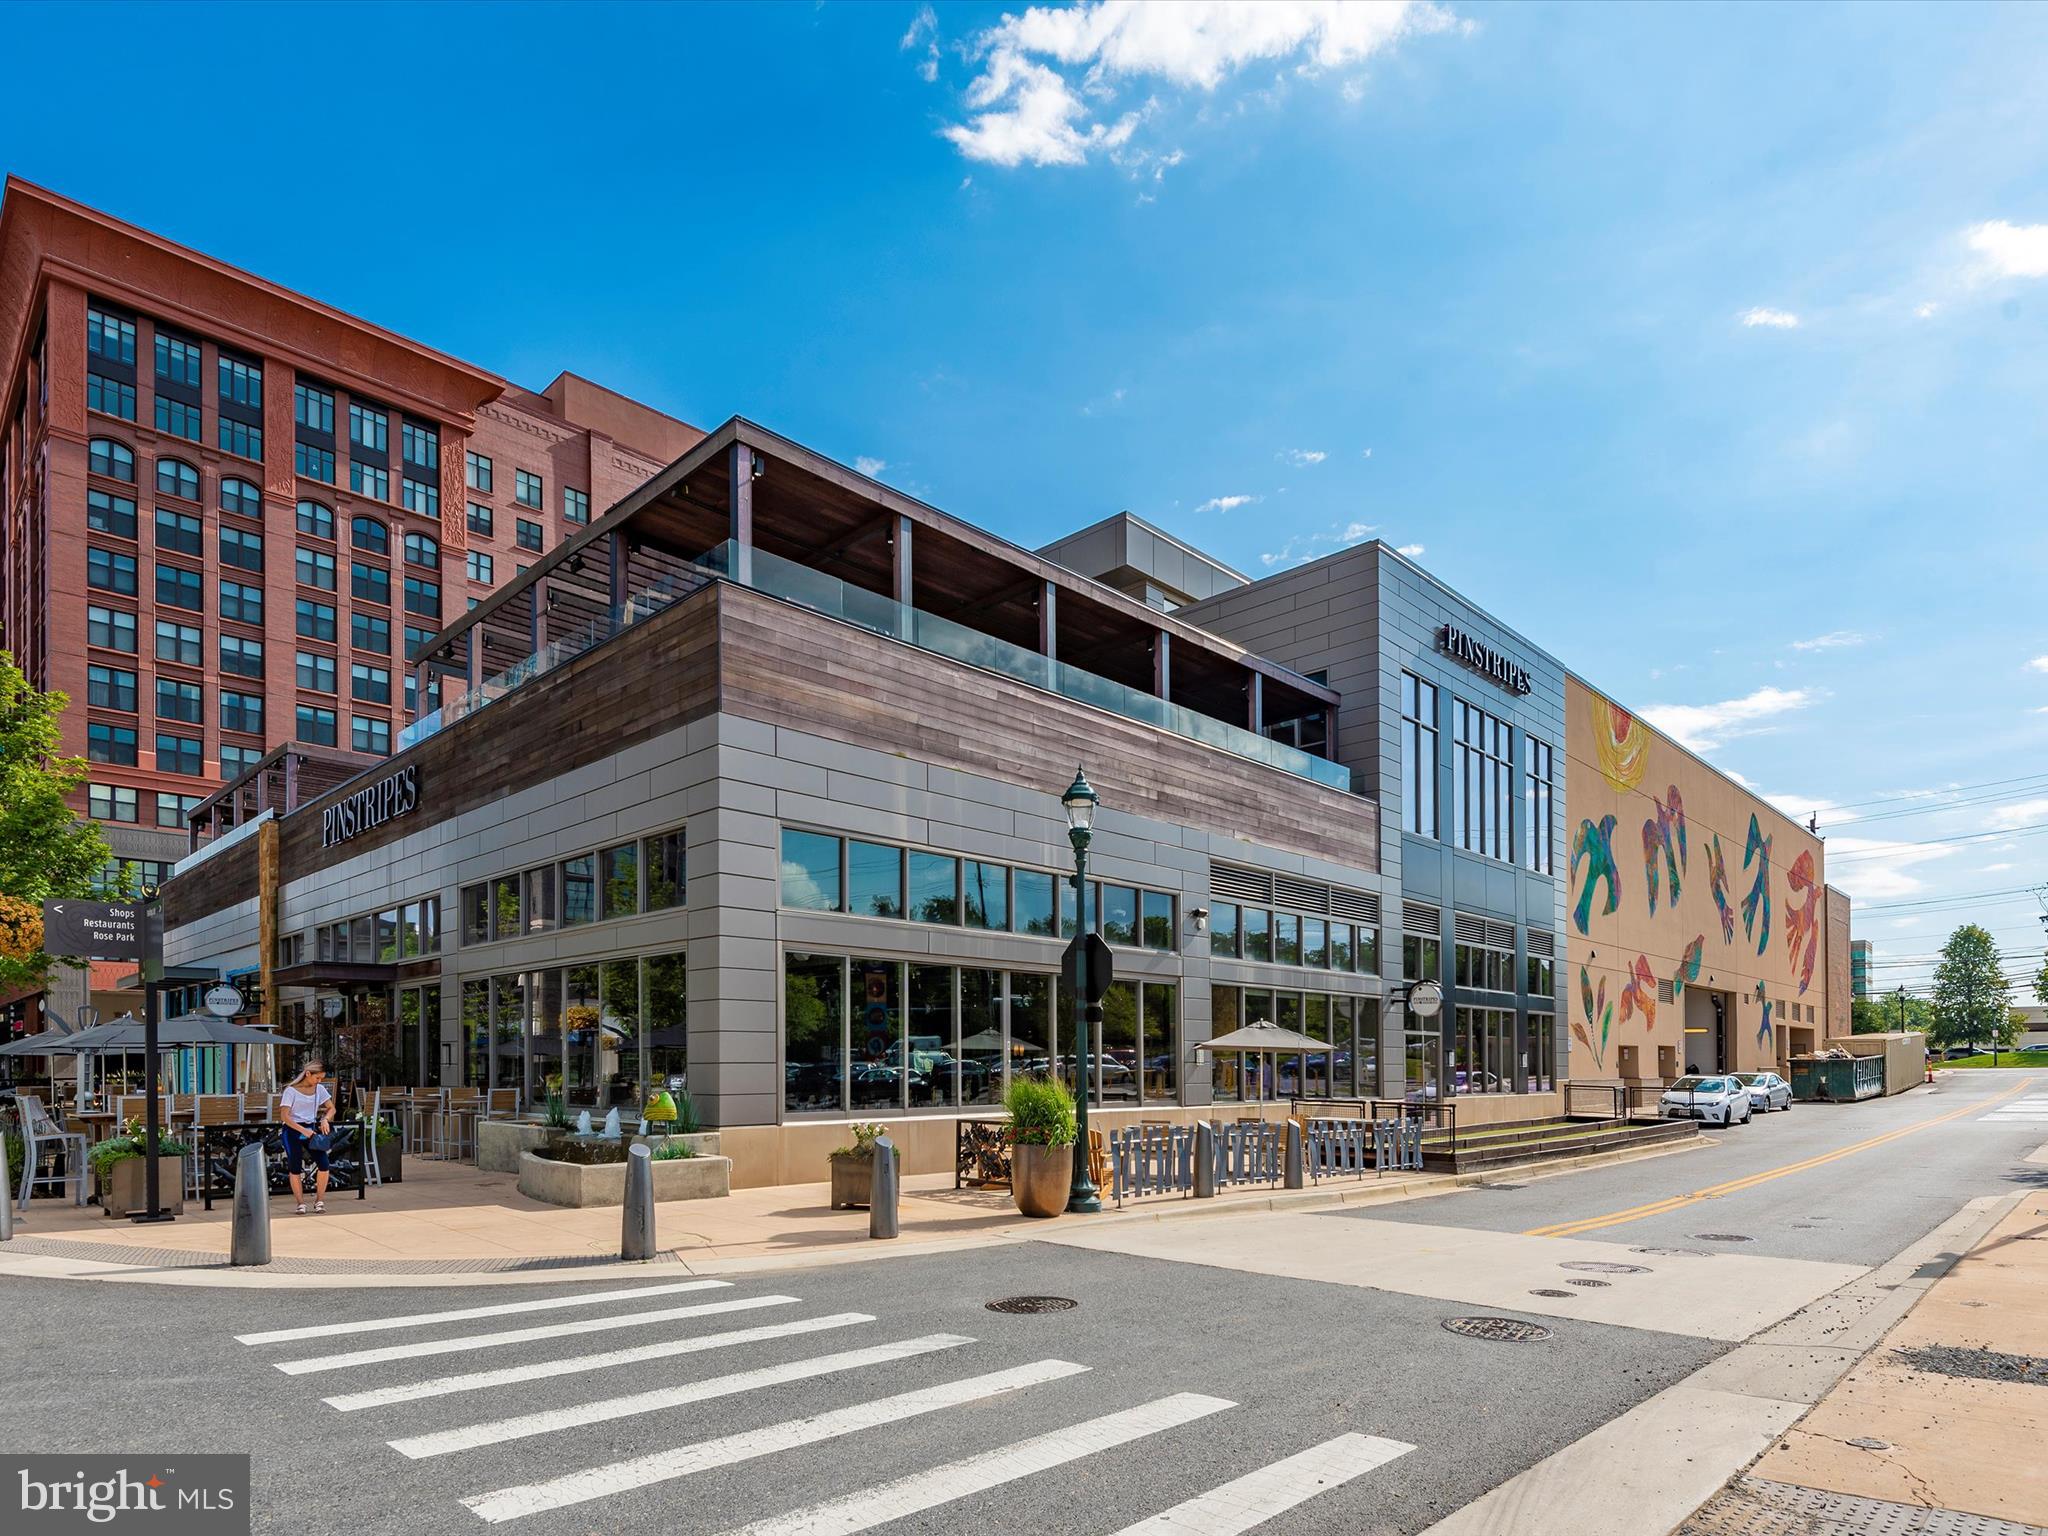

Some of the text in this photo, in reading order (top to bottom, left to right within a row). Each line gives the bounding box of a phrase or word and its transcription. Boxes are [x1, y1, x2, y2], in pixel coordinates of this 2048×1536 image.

[1447, 625, 1532, 696] PINSTRIPES
[322, 764, 416, 848] PINSTRIPES
[109, 908, 135, 919] Shops
[83, 918, 135, 930] Restaurants
[93, 931, 135, 942] Rose Park
